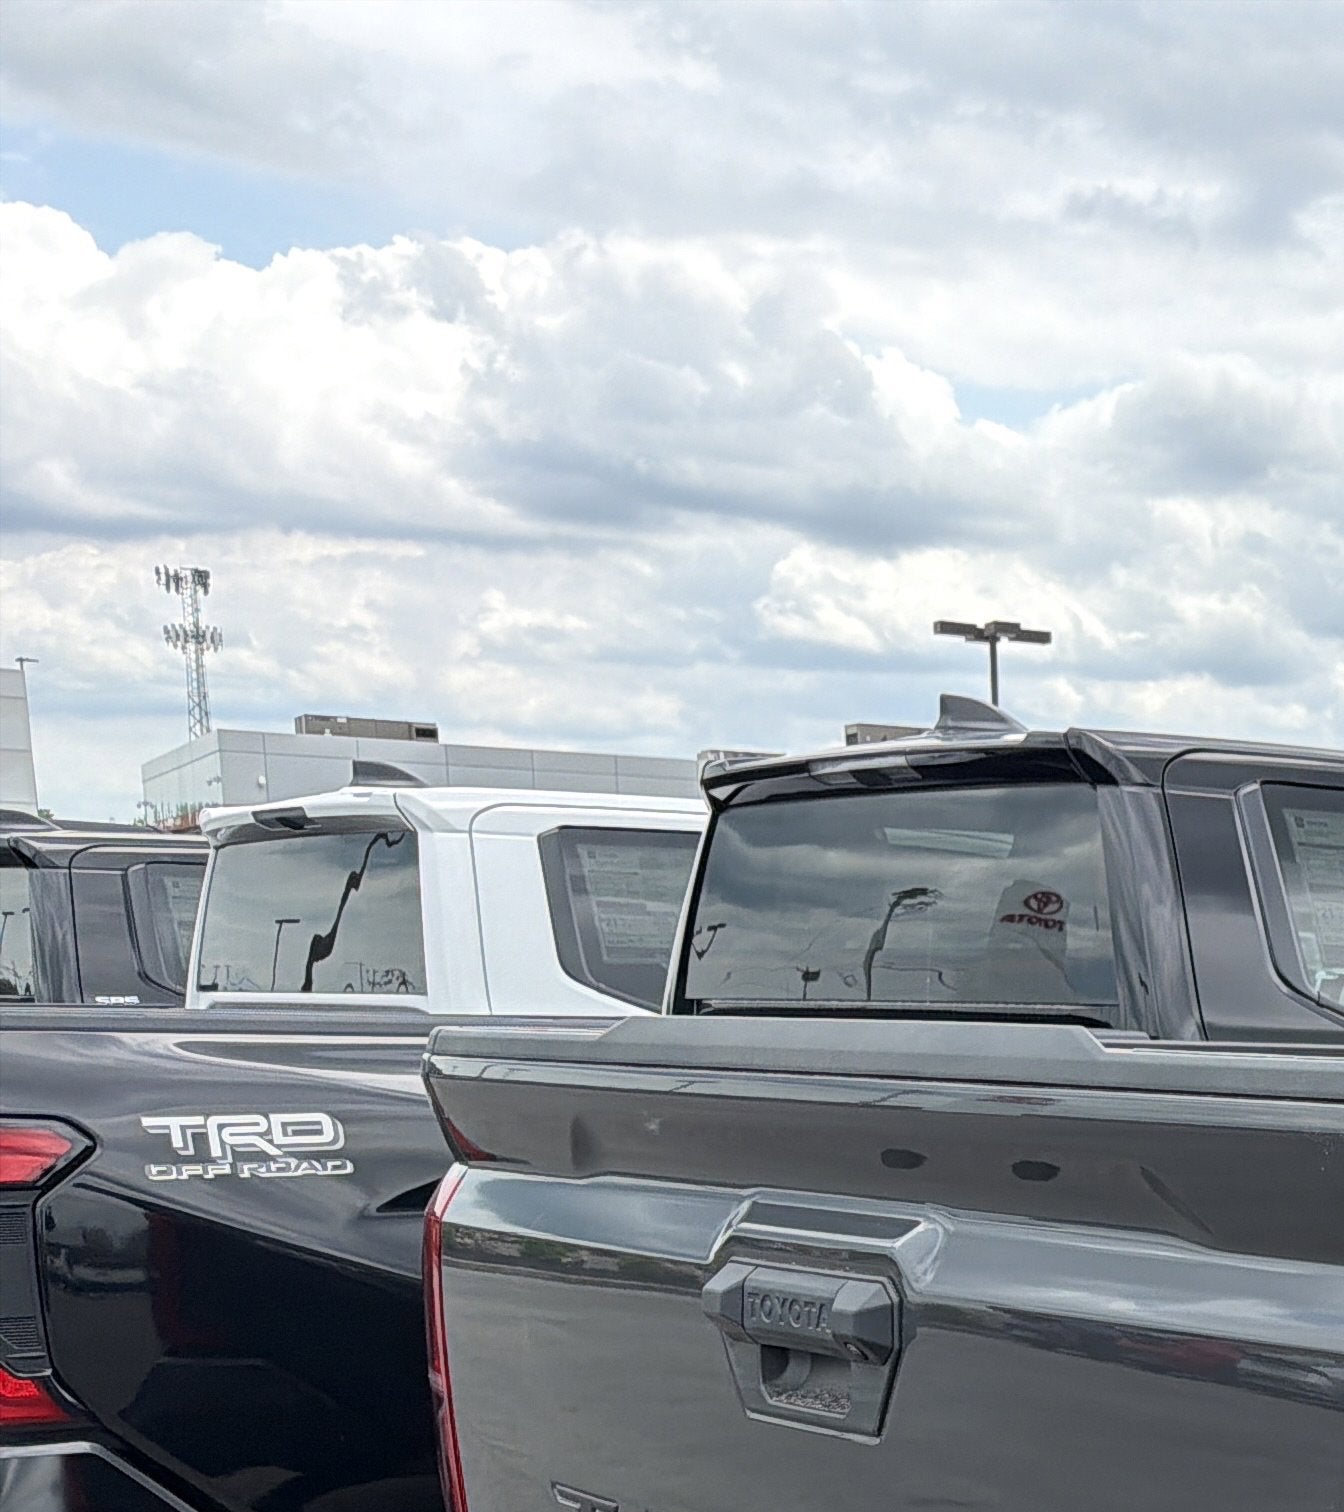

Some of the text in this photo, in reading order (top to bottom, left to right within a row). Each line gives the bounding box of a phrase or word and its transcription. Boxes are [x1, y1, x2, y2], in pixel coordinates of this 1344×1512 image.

[140, 1112, 345, 1160] TRD
[145, 1159, 354, 1180] OFF ROAD
[747, 1292, 832, 1334] TOYOTA
